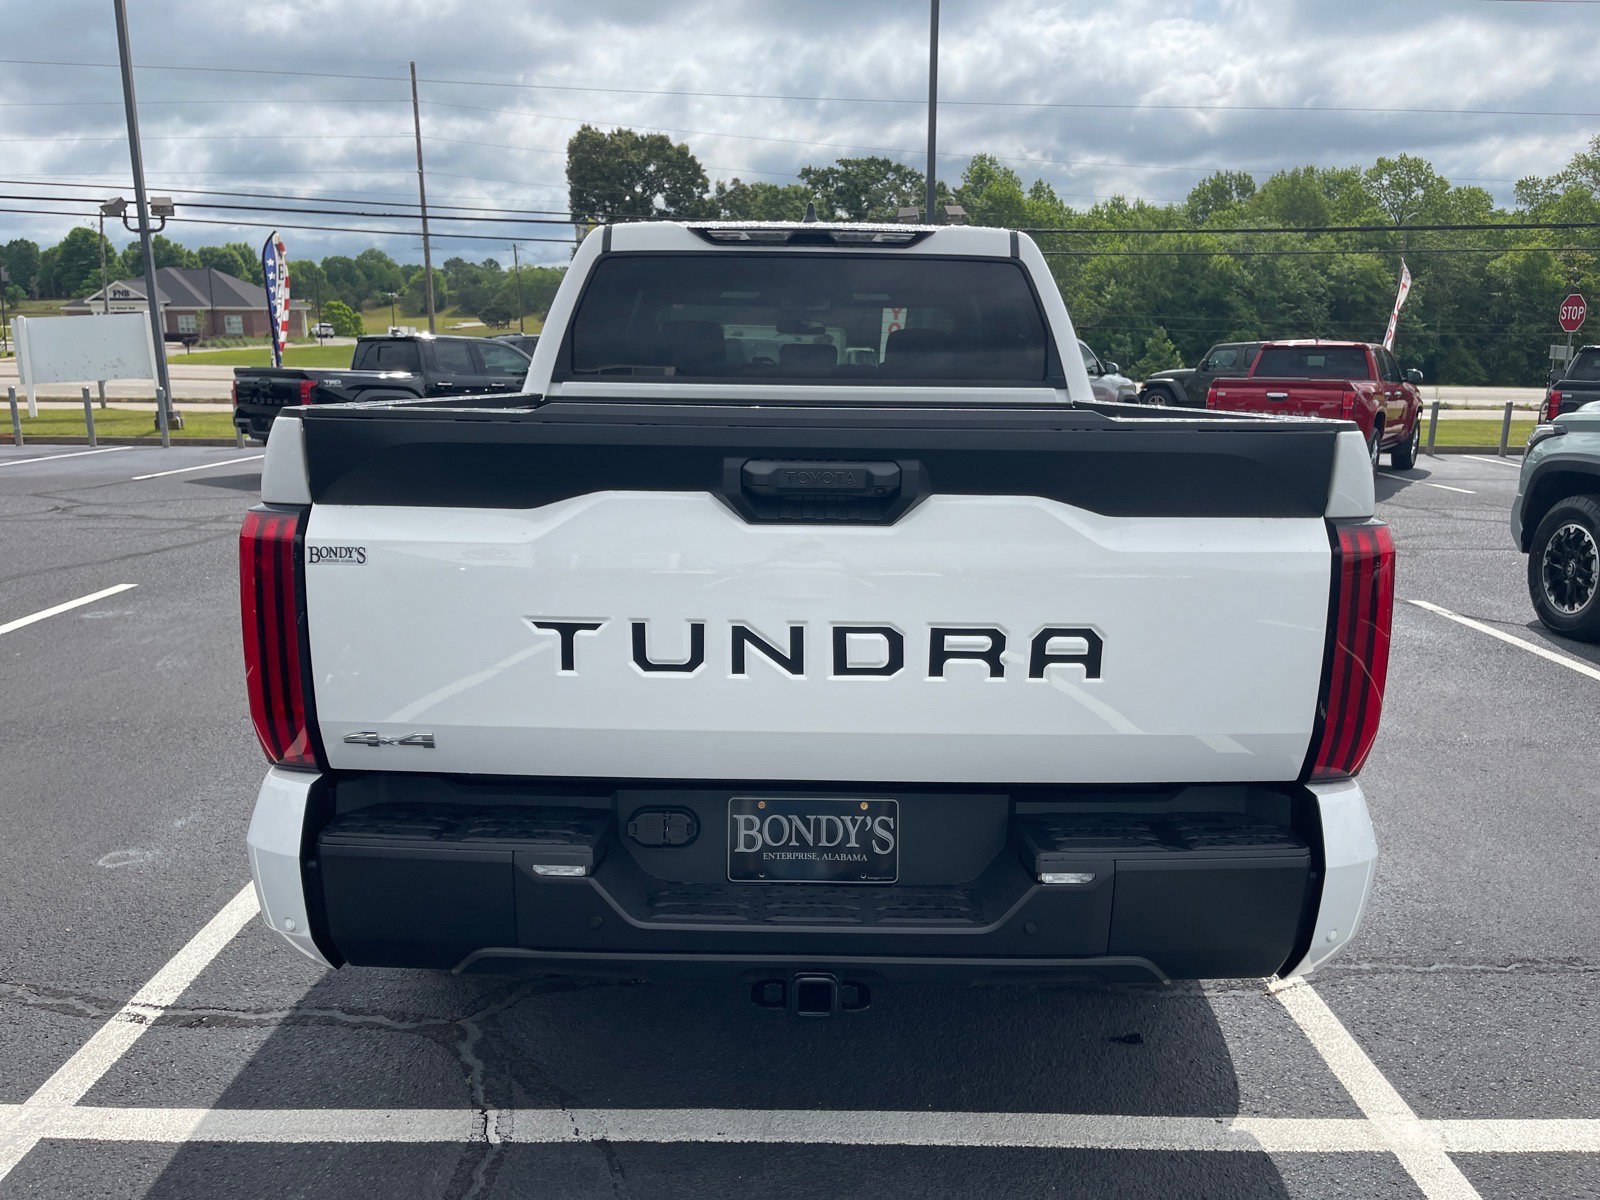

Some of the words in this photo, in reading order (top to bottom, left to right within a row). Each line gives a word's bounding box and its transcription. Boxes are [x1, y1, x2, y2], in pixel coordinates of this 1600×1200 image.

[1560, 305, 1585, 321] STOP
[784, 471, 857, 485] TOYOTA
[307, 545, 367, 564] BONDY'S
[524, 617, 1106, 683] TUNDRA
[733, 814, 895, 855] BONDY'S
[762, 852, 820, 861] ENTERPRISE,
[821, 853, 868, 862] ALABAMA
